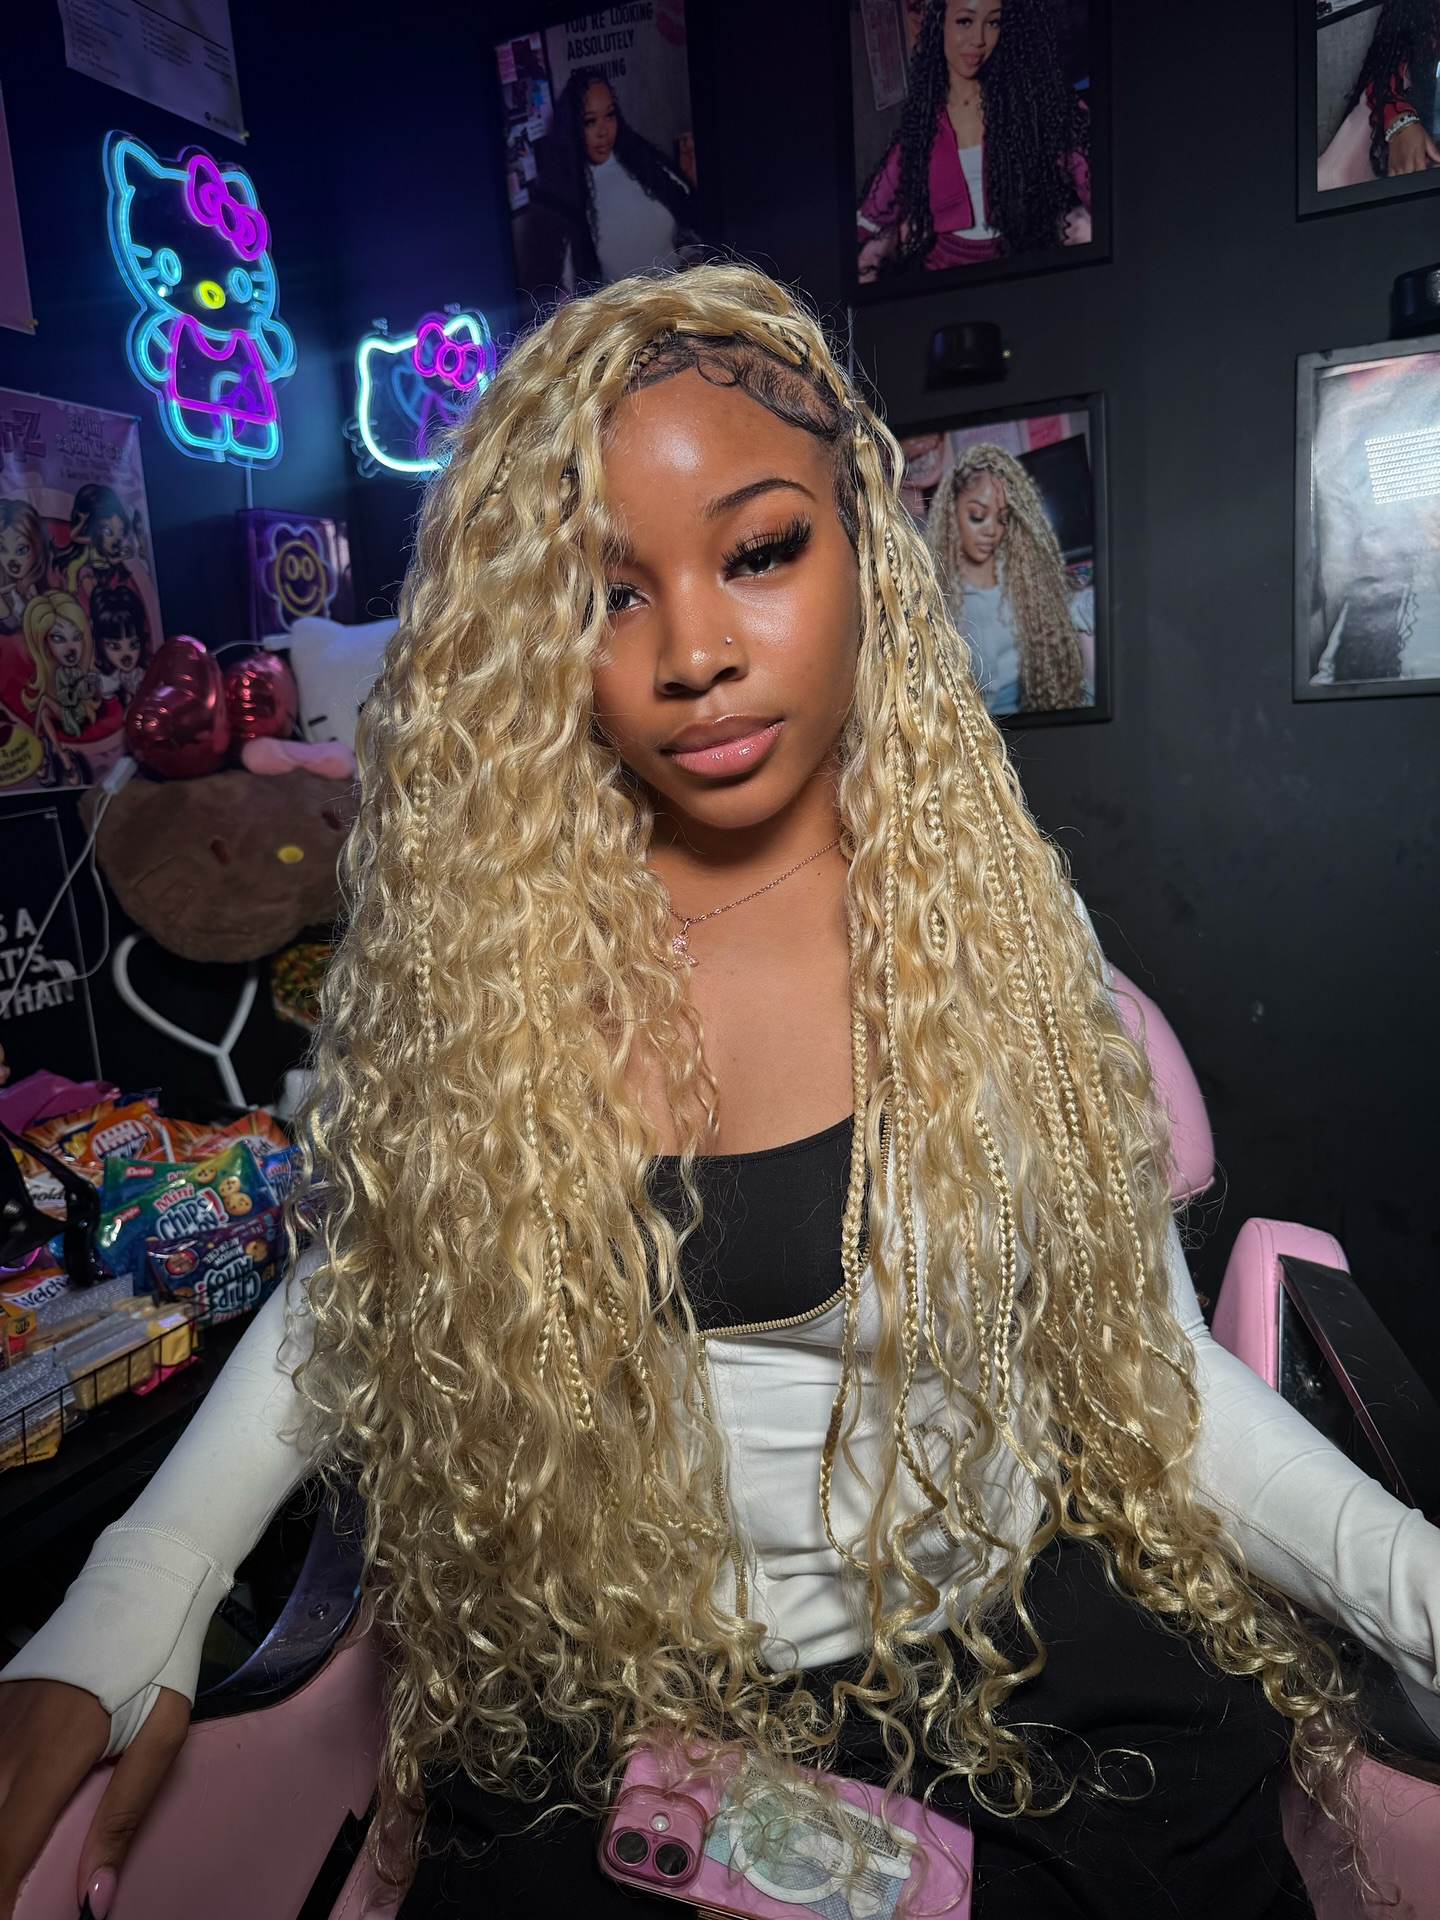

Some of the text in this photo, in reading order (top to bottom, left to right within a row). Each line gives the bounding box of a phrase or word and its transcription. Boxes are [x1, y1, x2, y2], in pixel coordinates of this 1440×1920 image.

[565, 2, 653, 34] YOURE LOOKING
[567, 30, 635, 61] ABSOLUTELY
[571, 58, 627, 80] NING
[14, 906, 40, 940] A
[30, 1184, 65, 1201] Gold
[152, 1183, 195, 1214] Mini
[155, 1197, 208, 1241] Chips
[11, 1274, 70, 1307] Welch'
